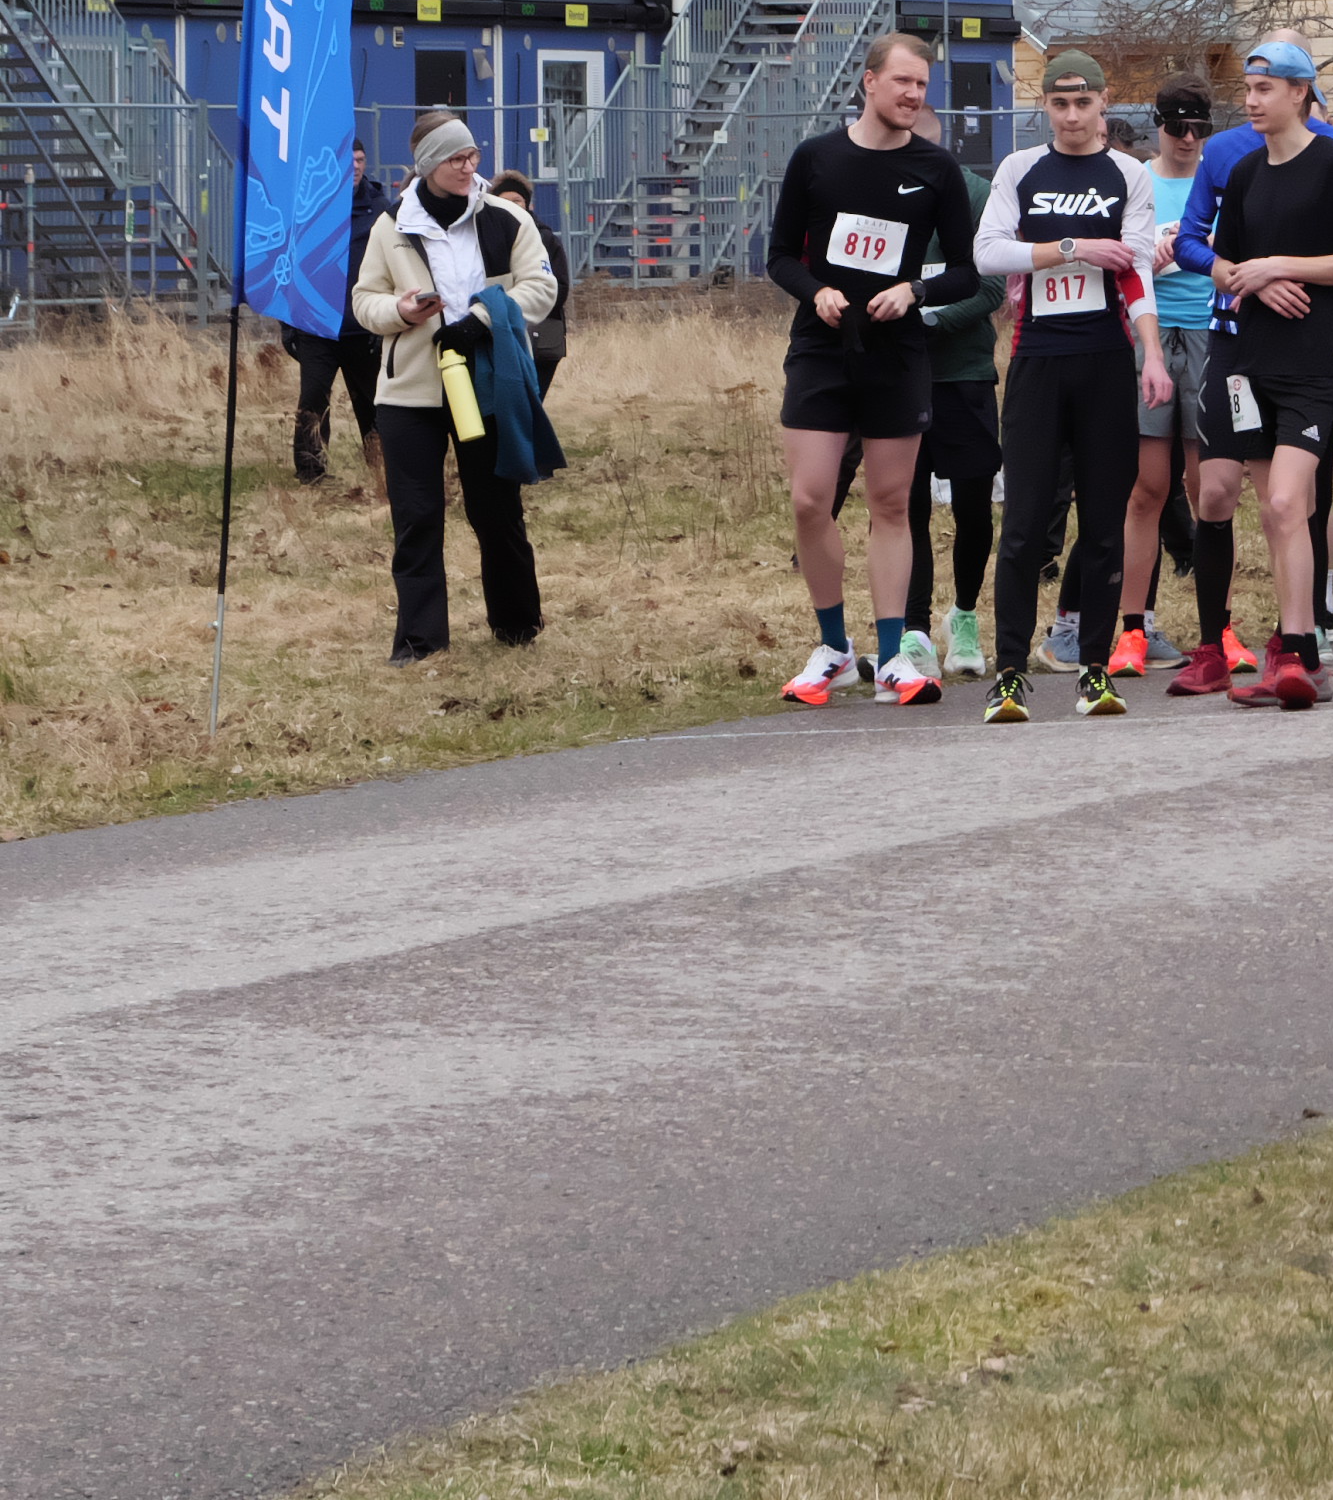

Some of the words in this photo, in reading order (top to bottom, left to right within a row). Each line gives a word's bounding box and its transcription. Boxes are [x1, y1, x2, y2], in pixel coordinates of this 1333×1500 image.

[420, 3, 437, 15] Rental
[568, 9, 585, 21] Rental
[844, 232, 887, 261] 819
[1045, 274, 1087, 303] 817
